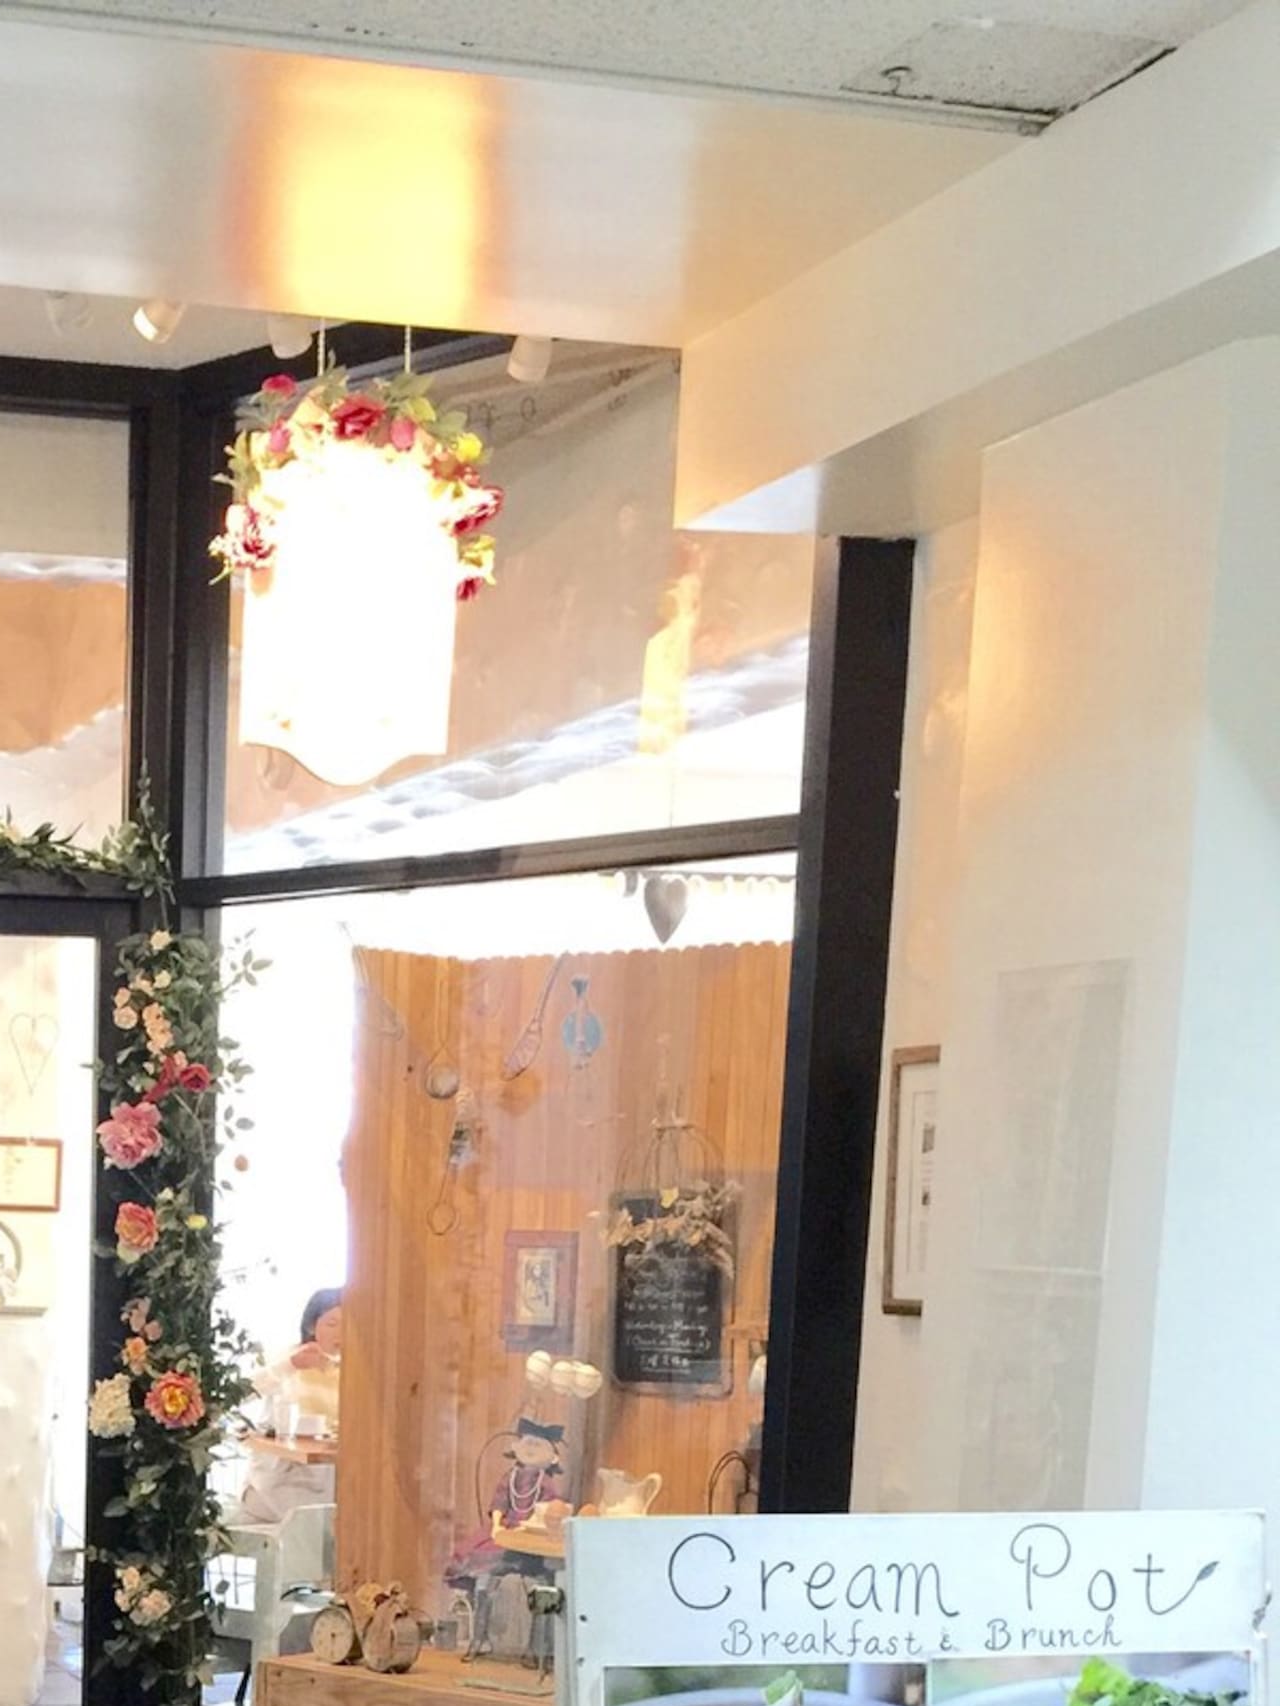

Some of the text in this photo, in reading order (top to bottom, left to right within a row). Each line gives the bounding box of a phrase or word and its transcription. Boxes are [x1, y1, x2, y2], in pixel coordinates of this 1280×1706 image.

[668, 1523, 1218, 1618] Cream Pot
[721, 1618, 922, 1657] Breakfast
[984, 1614, 1123, 1651] Brunch
